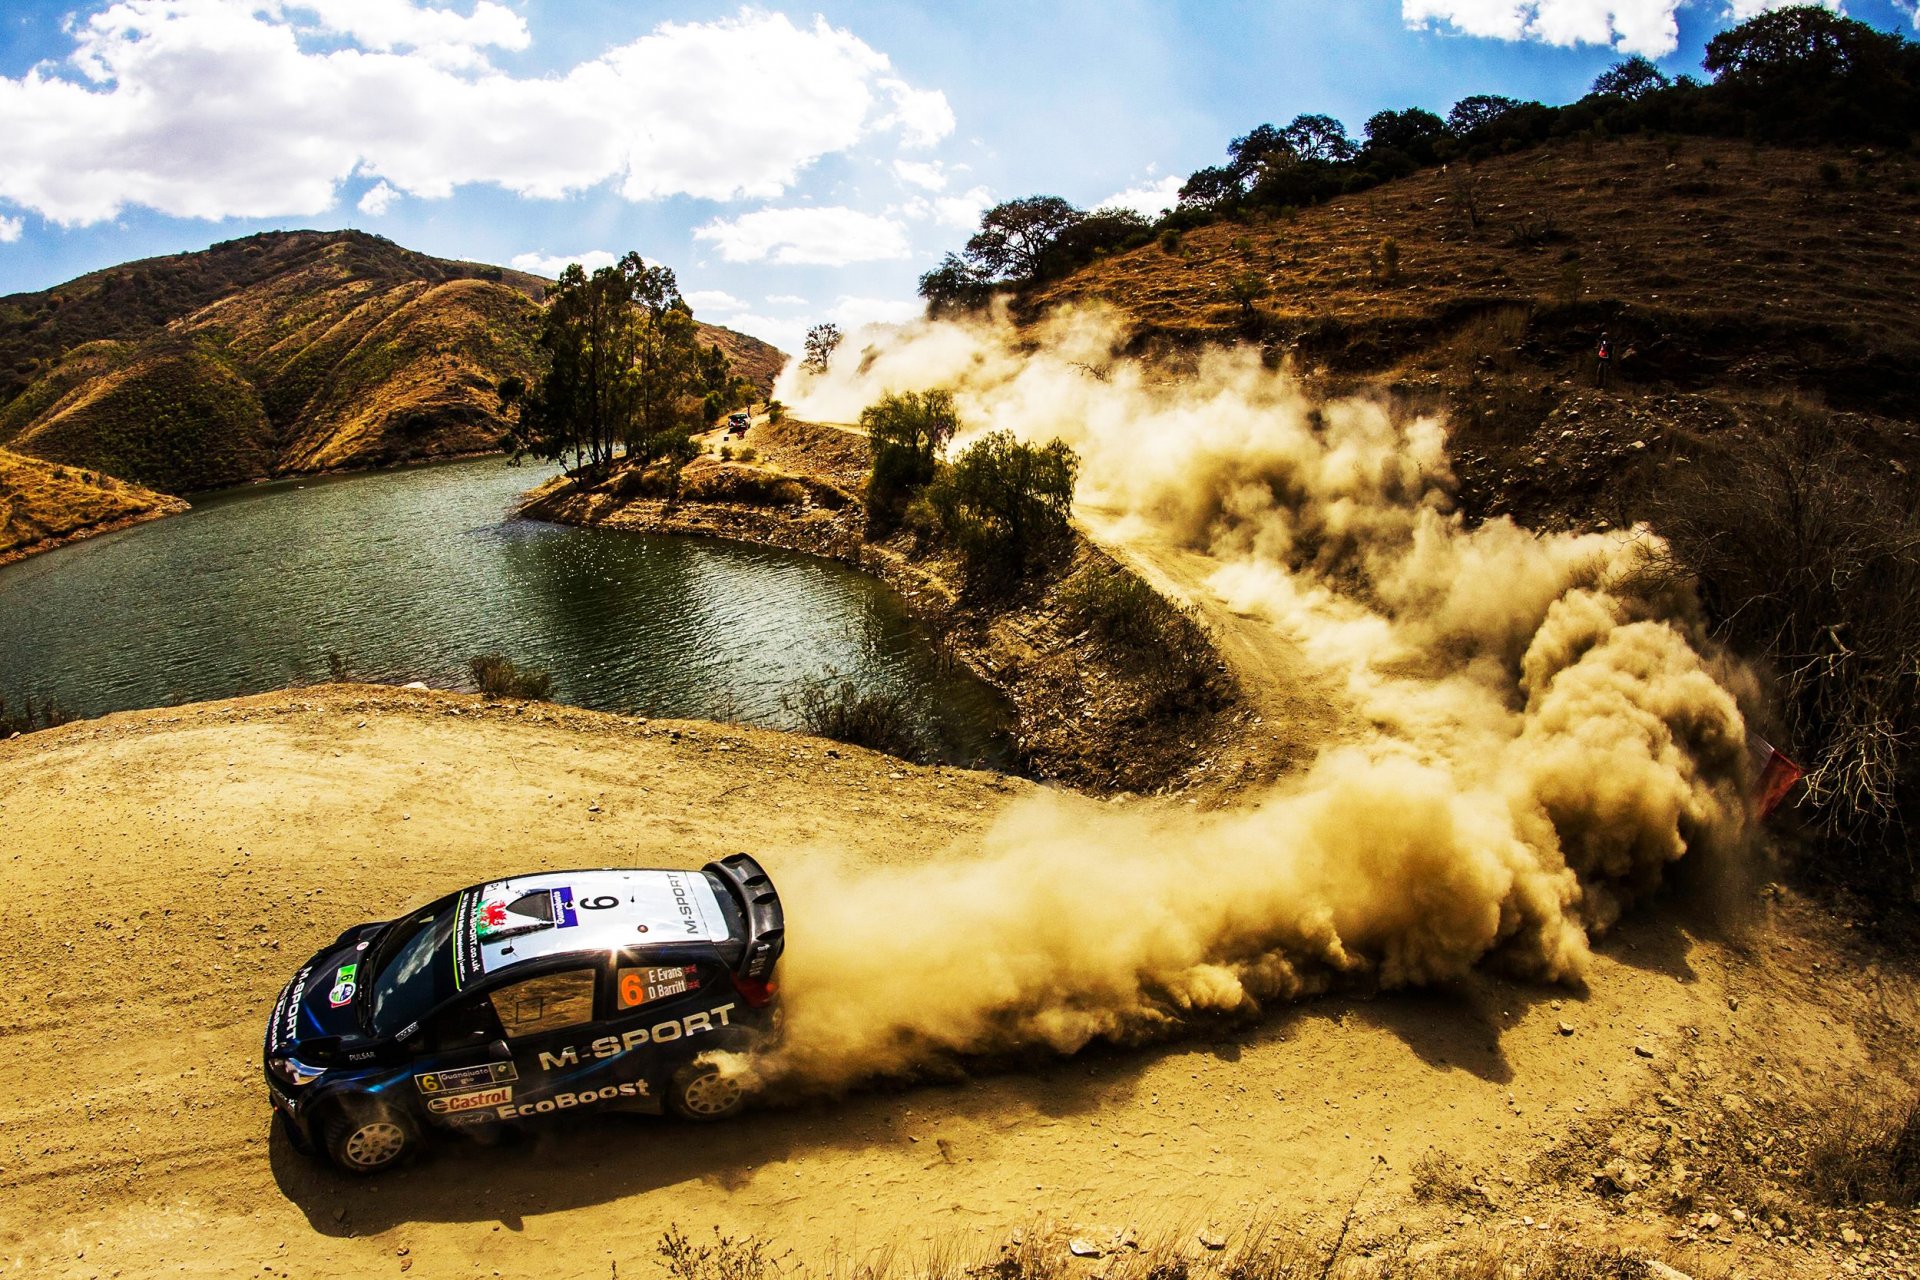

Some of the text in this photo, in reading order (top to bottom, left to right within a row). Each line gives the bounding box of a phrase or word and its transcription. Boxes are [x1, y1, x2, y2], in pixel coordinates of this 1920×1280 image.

[579, 896, 620, 911] 6
[648, 967, 683, 983] E Evans
[621, 974, 644, 1006] 6
[648, 980, 686, 999] D Barritt
[537, 1002, 736, 1071] M-SPORT
[422, 1075, 439, 1091] 6
[440, 1068, 489, 1081] Guanajuato
[449, 1089, 508, 1110] Castrol
[496, 1078, 651, 1121] EcoBoost
